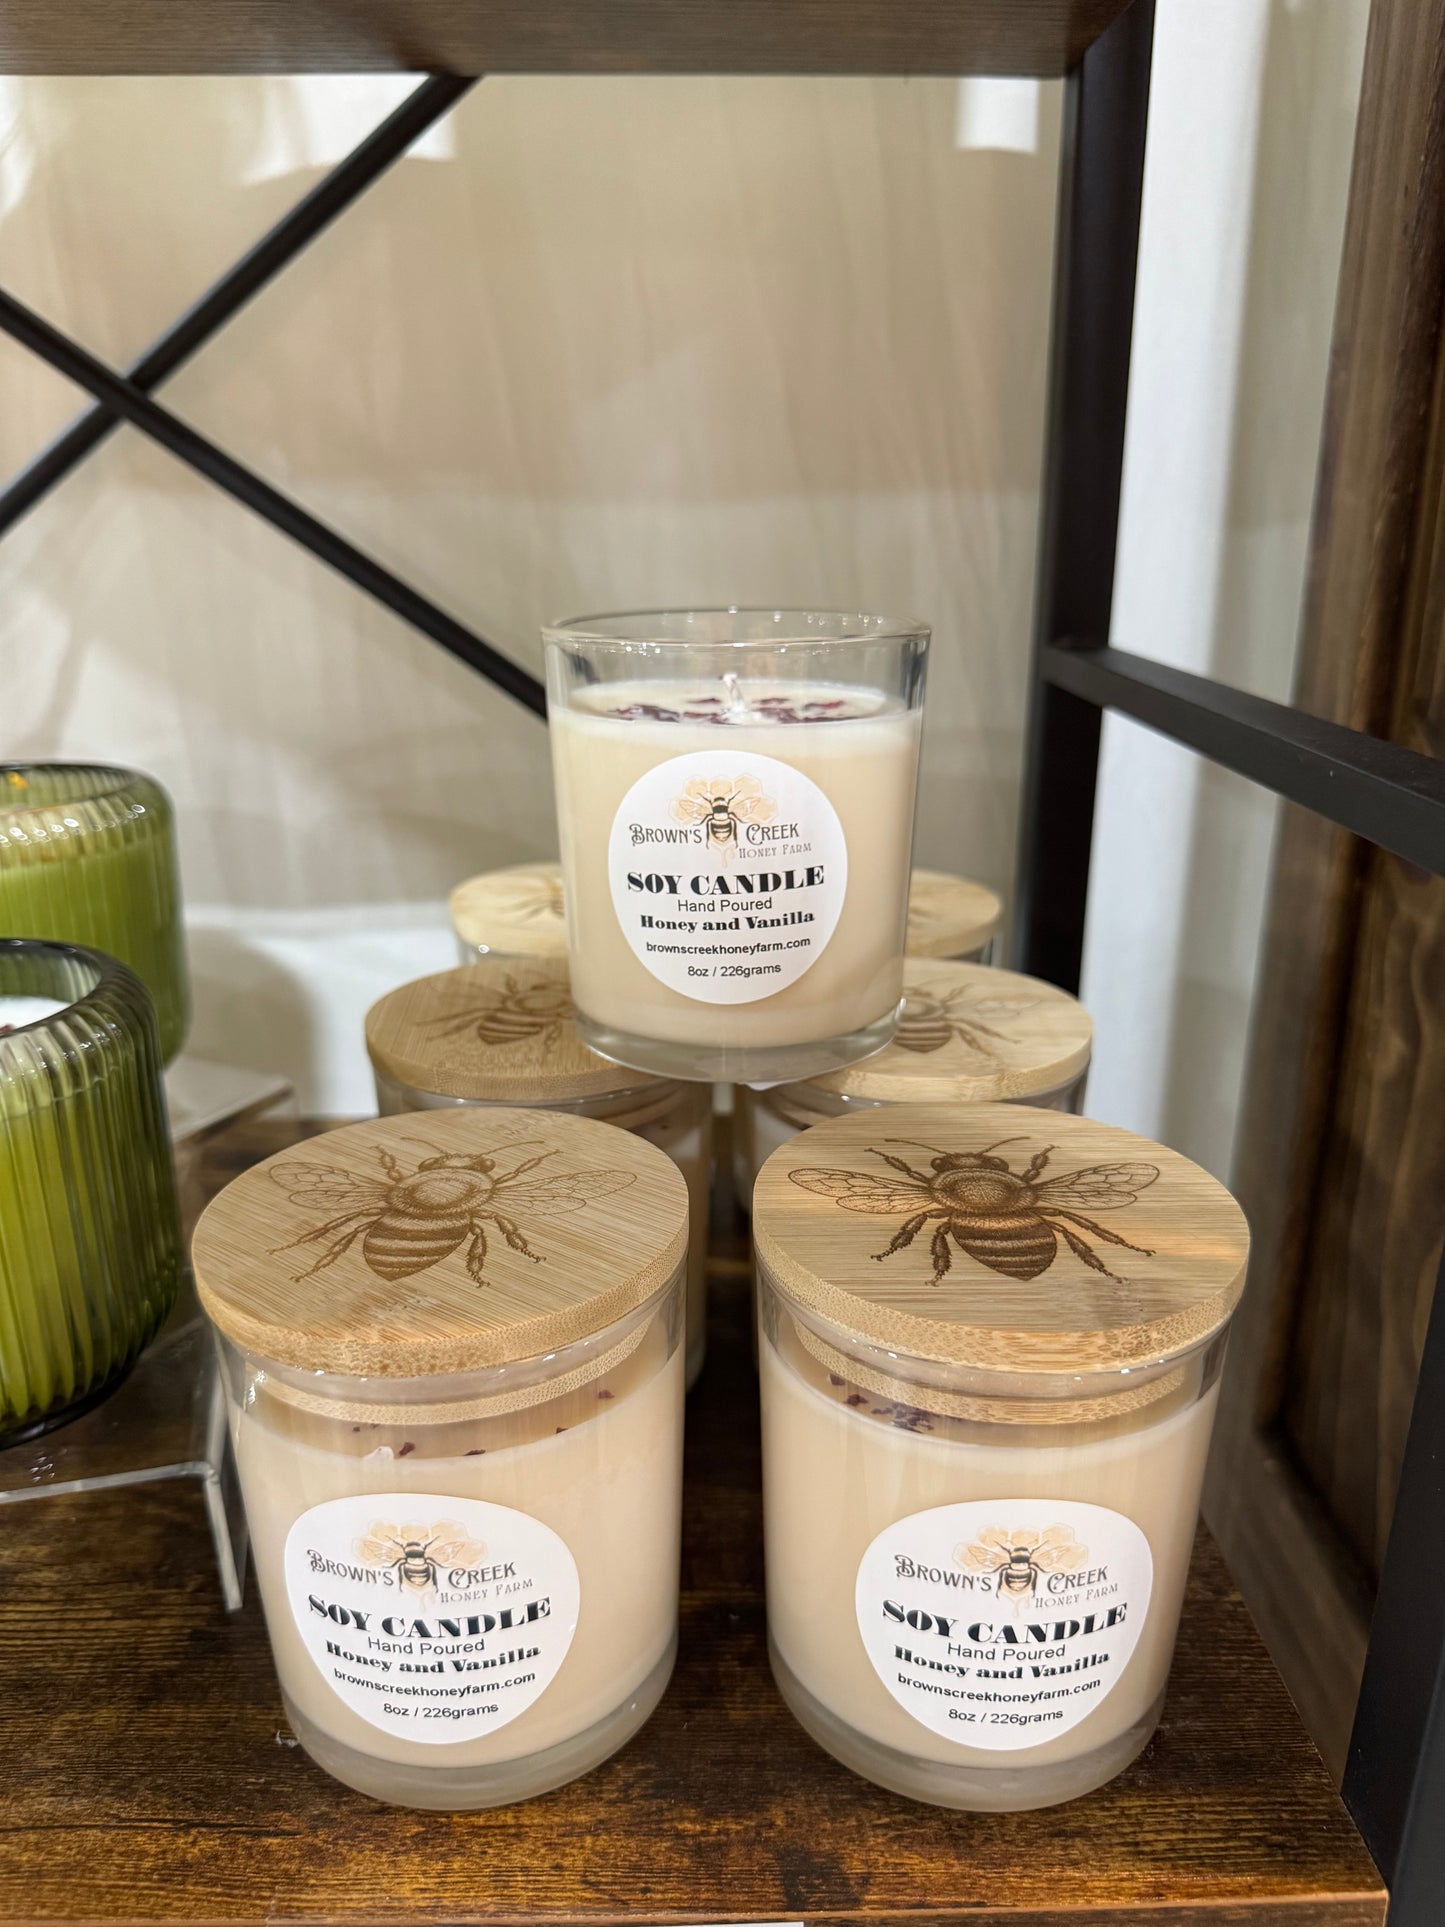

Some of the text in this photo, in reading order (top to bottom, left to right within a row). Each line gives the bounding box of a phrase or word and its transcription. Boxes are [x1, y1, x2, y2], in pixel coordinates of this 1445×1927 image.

[629, 823, 799, 847] BROWN'S CREEK
[739, 843, 812, 859] HONEY FARM
[627, 865, 825, 895] SOY CANDLE
[678, 897, 772, 912] Hand Poured
[640, 912, 815, 933] Honey and Vanilla
[647, 937, 810, 955] brownscreekhoneyfarm.com
[688, 964, 781, 978] 8oz / 226grams
[307, 1550, 517, 1589] BROWN'S CREEK
[894, 1554, 1109, 1594] BROWN'S CREEK
[440, 1579, 533, 1603] HONEY FARM
[1035, 1584, 1118, 1608] HONEY FARM
[308, 1594, 551, 1638] SOY CANDLE
[882, 1600, 1128, 1644] SOY CANDLE
[326, 1641, 541, 1673] Honey and Vanilla
[368, 1637, 485, 1655] Hand Poured
[948, 1643, 1066, 1660] Hand Poured
[894, 1645, 1110, 1679] Honey and Vanilla
[334, 1669, 536, 1698] brownscreekhoneyfarm.com
[898, 1673, 1100, 1703] brownscreekhoneyfarm.com
[384, 1703, 498, 1719] 8oz / 226grams
[949, 1709, 1064, 1726] 8oz / 226grams
